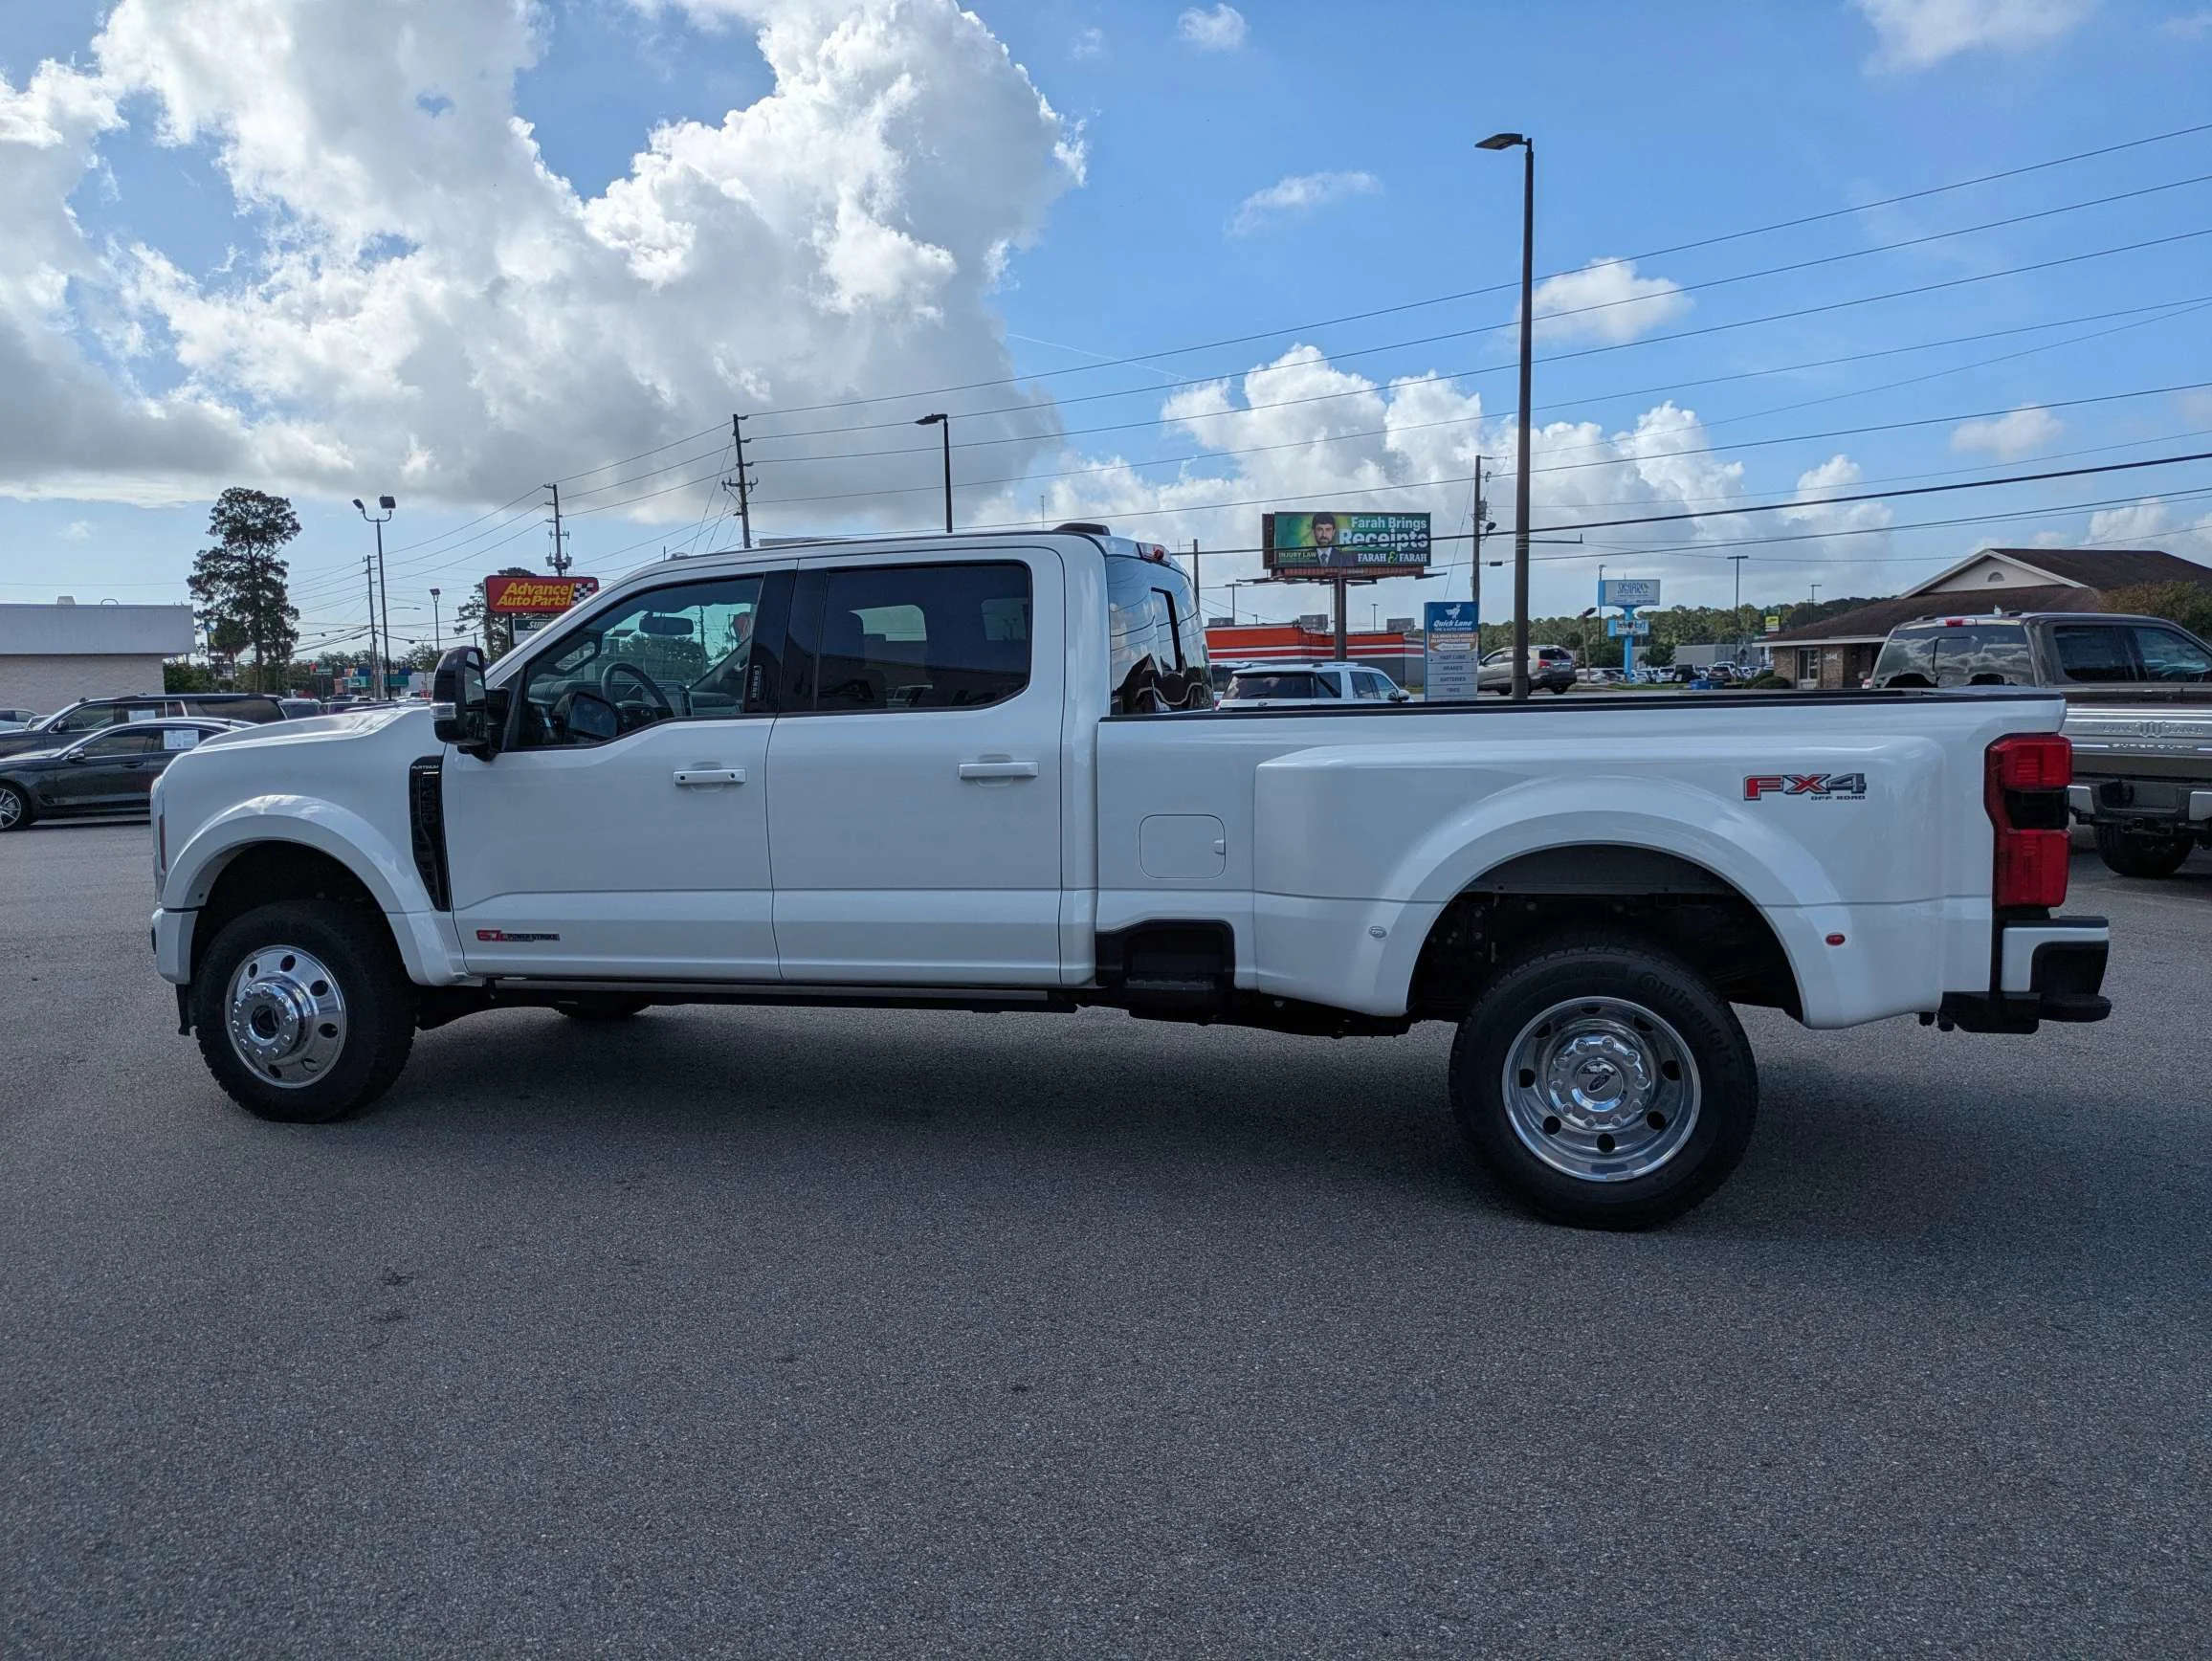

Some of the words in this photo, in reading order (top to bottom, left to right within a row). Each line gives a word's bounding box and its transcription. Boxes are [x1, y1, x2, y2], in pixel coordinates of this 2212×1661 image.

[1351, 517, 1385, 529] Farah
[1388, 517, 1427, 532] Brings
[1339, 528, 1428, 551] Receipts
[1358, 553, 1386, 563] FARAH
[1399, 553, 1427, 563] FARAH
[504, 582, 568, 595] Advance
[497, 595, 531, 606] Auto
[531, 595, 566, 606] Parts
[1743, 773, 1867, 801] FX4
